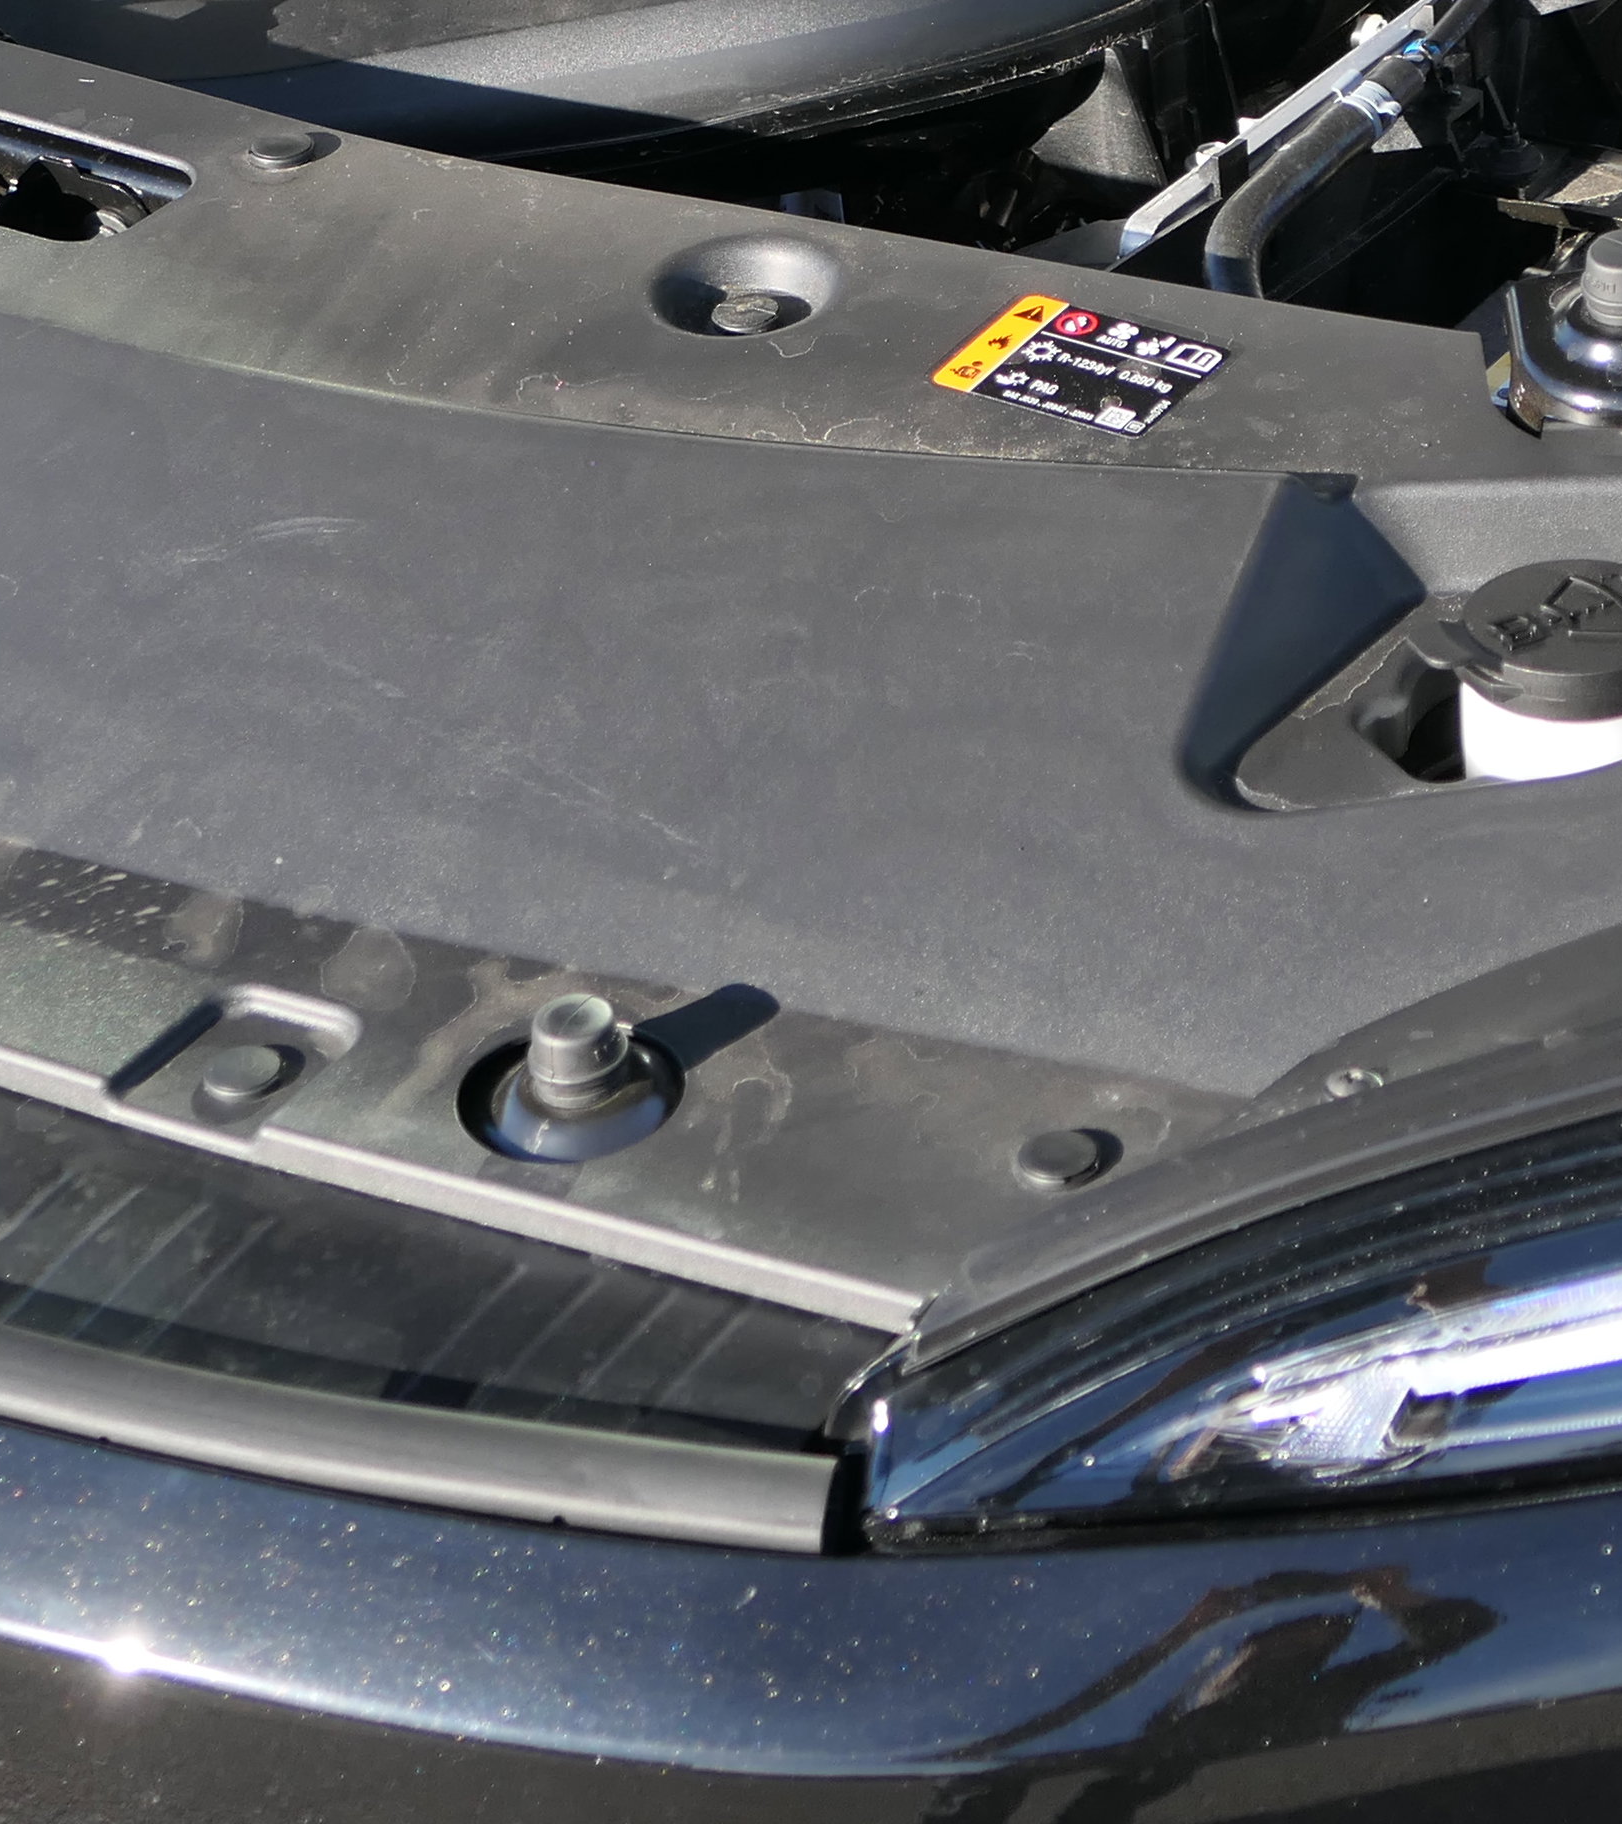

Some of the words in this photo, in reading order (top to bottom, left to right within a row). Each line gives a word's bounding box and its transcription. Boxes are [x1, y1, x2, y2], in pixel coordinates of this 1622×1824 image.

[1096, 334, 1129, 349] AUTO
[1057, 353, 1117, 376] R-1234yf
[1154, 379, 1174, 394] kg
[1030, 379, 1060, 395] PAG
